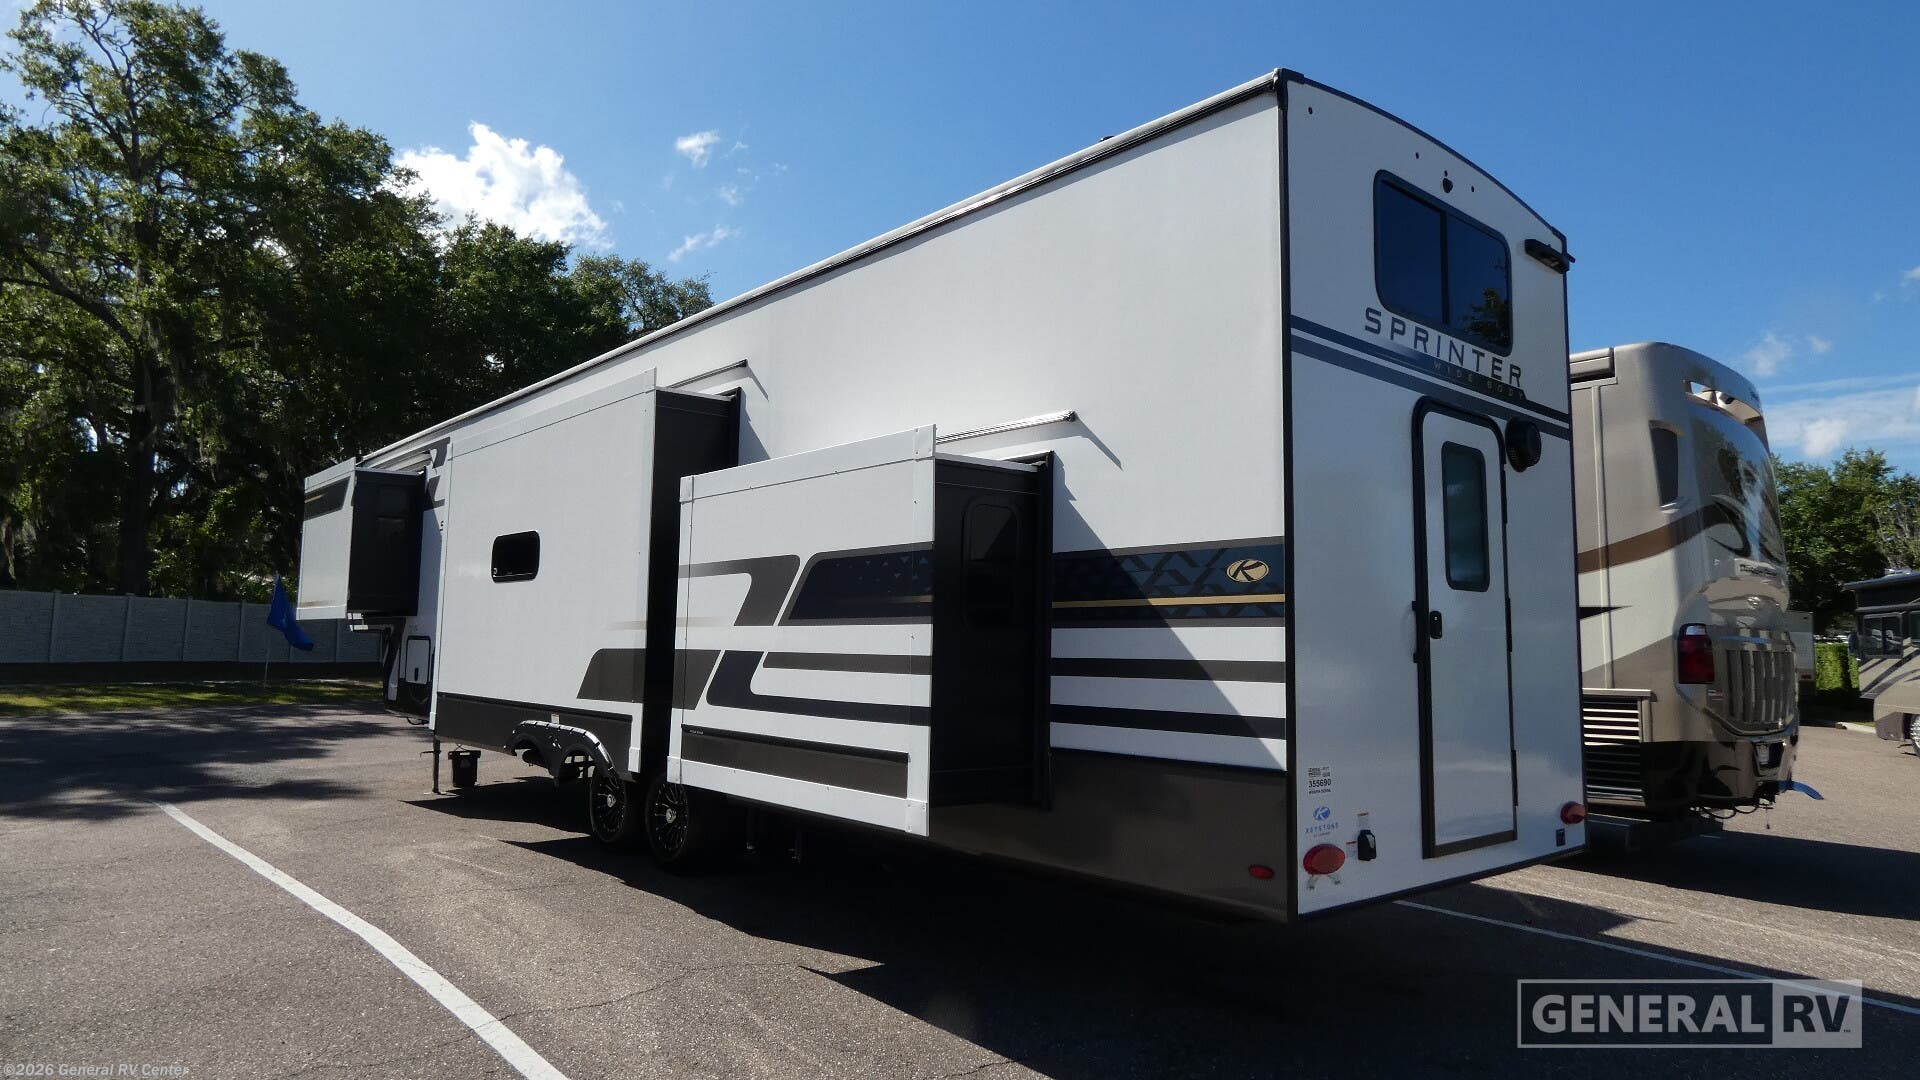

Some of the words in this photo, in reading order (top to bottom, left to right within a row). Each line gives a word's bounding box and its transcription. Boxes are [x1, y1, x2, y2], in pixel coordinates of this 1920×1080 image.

[1365, 306, 1522, 388] SPRINTER
[1432, 360, 1473, 383] WIDE
[1487, 380, 1524, 400] BODY
[1308, 778, 1332, 788] 355690
